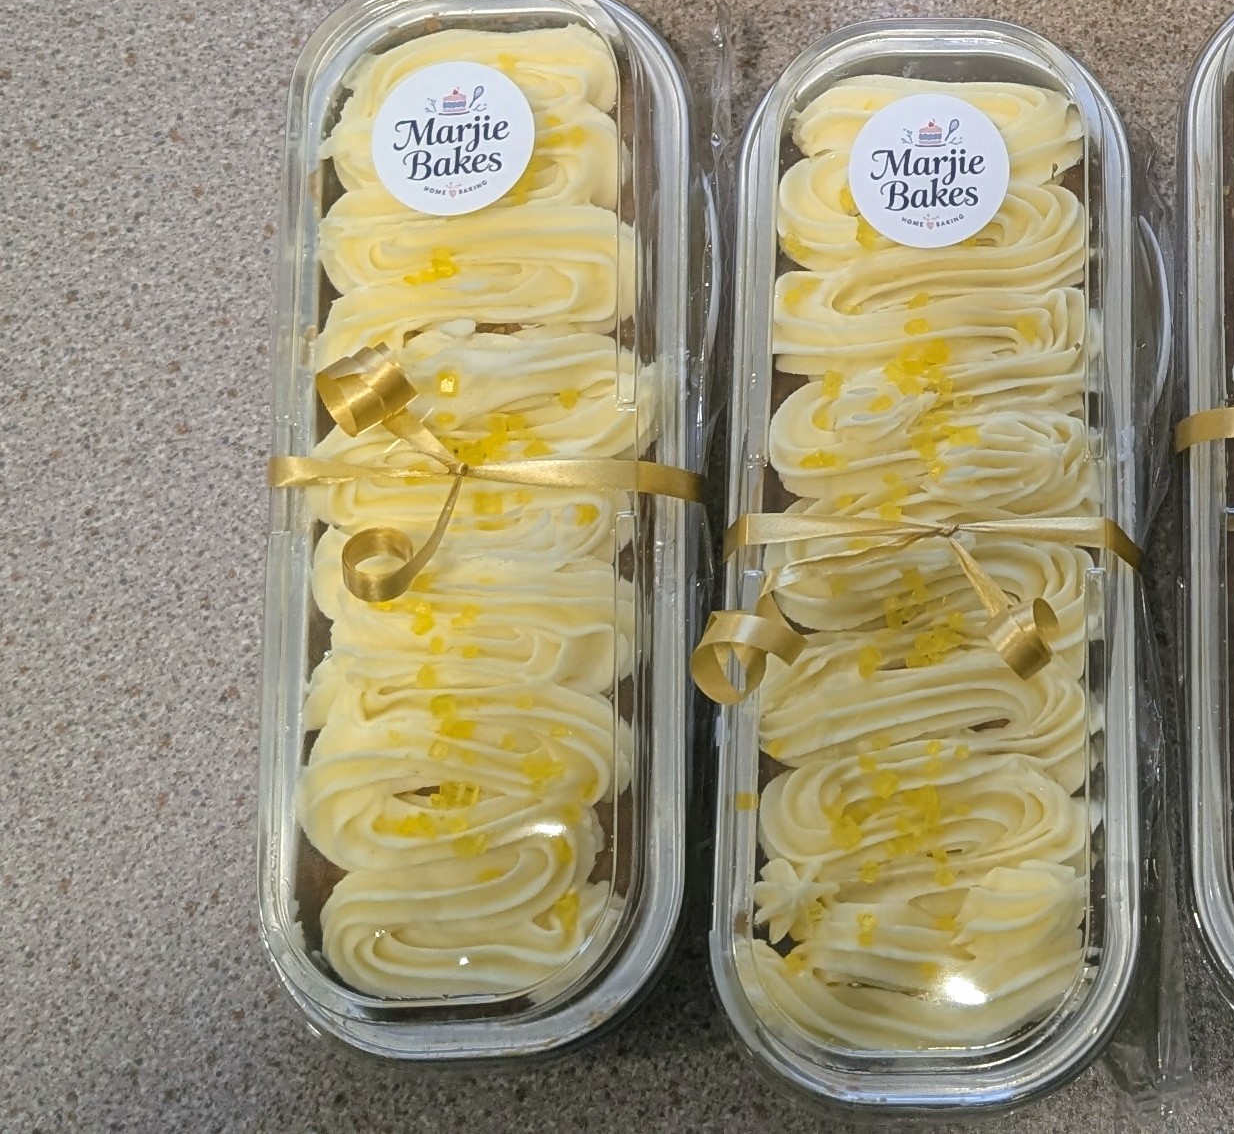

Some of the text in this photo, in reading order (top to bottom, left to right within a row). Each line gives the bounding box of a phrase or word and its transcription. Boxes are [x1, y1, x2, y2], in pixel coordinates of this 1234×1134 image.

[393, 115, 510, 152] Marjie
[403, 146, 502, 181] Bakes
[870, 149, 985, 185] Marjie
[424, 180, 488, 196] HOME BAKING
[880, 178, 979, 211] Bakes
[901, 214, 964, 227] HOME BAKING
